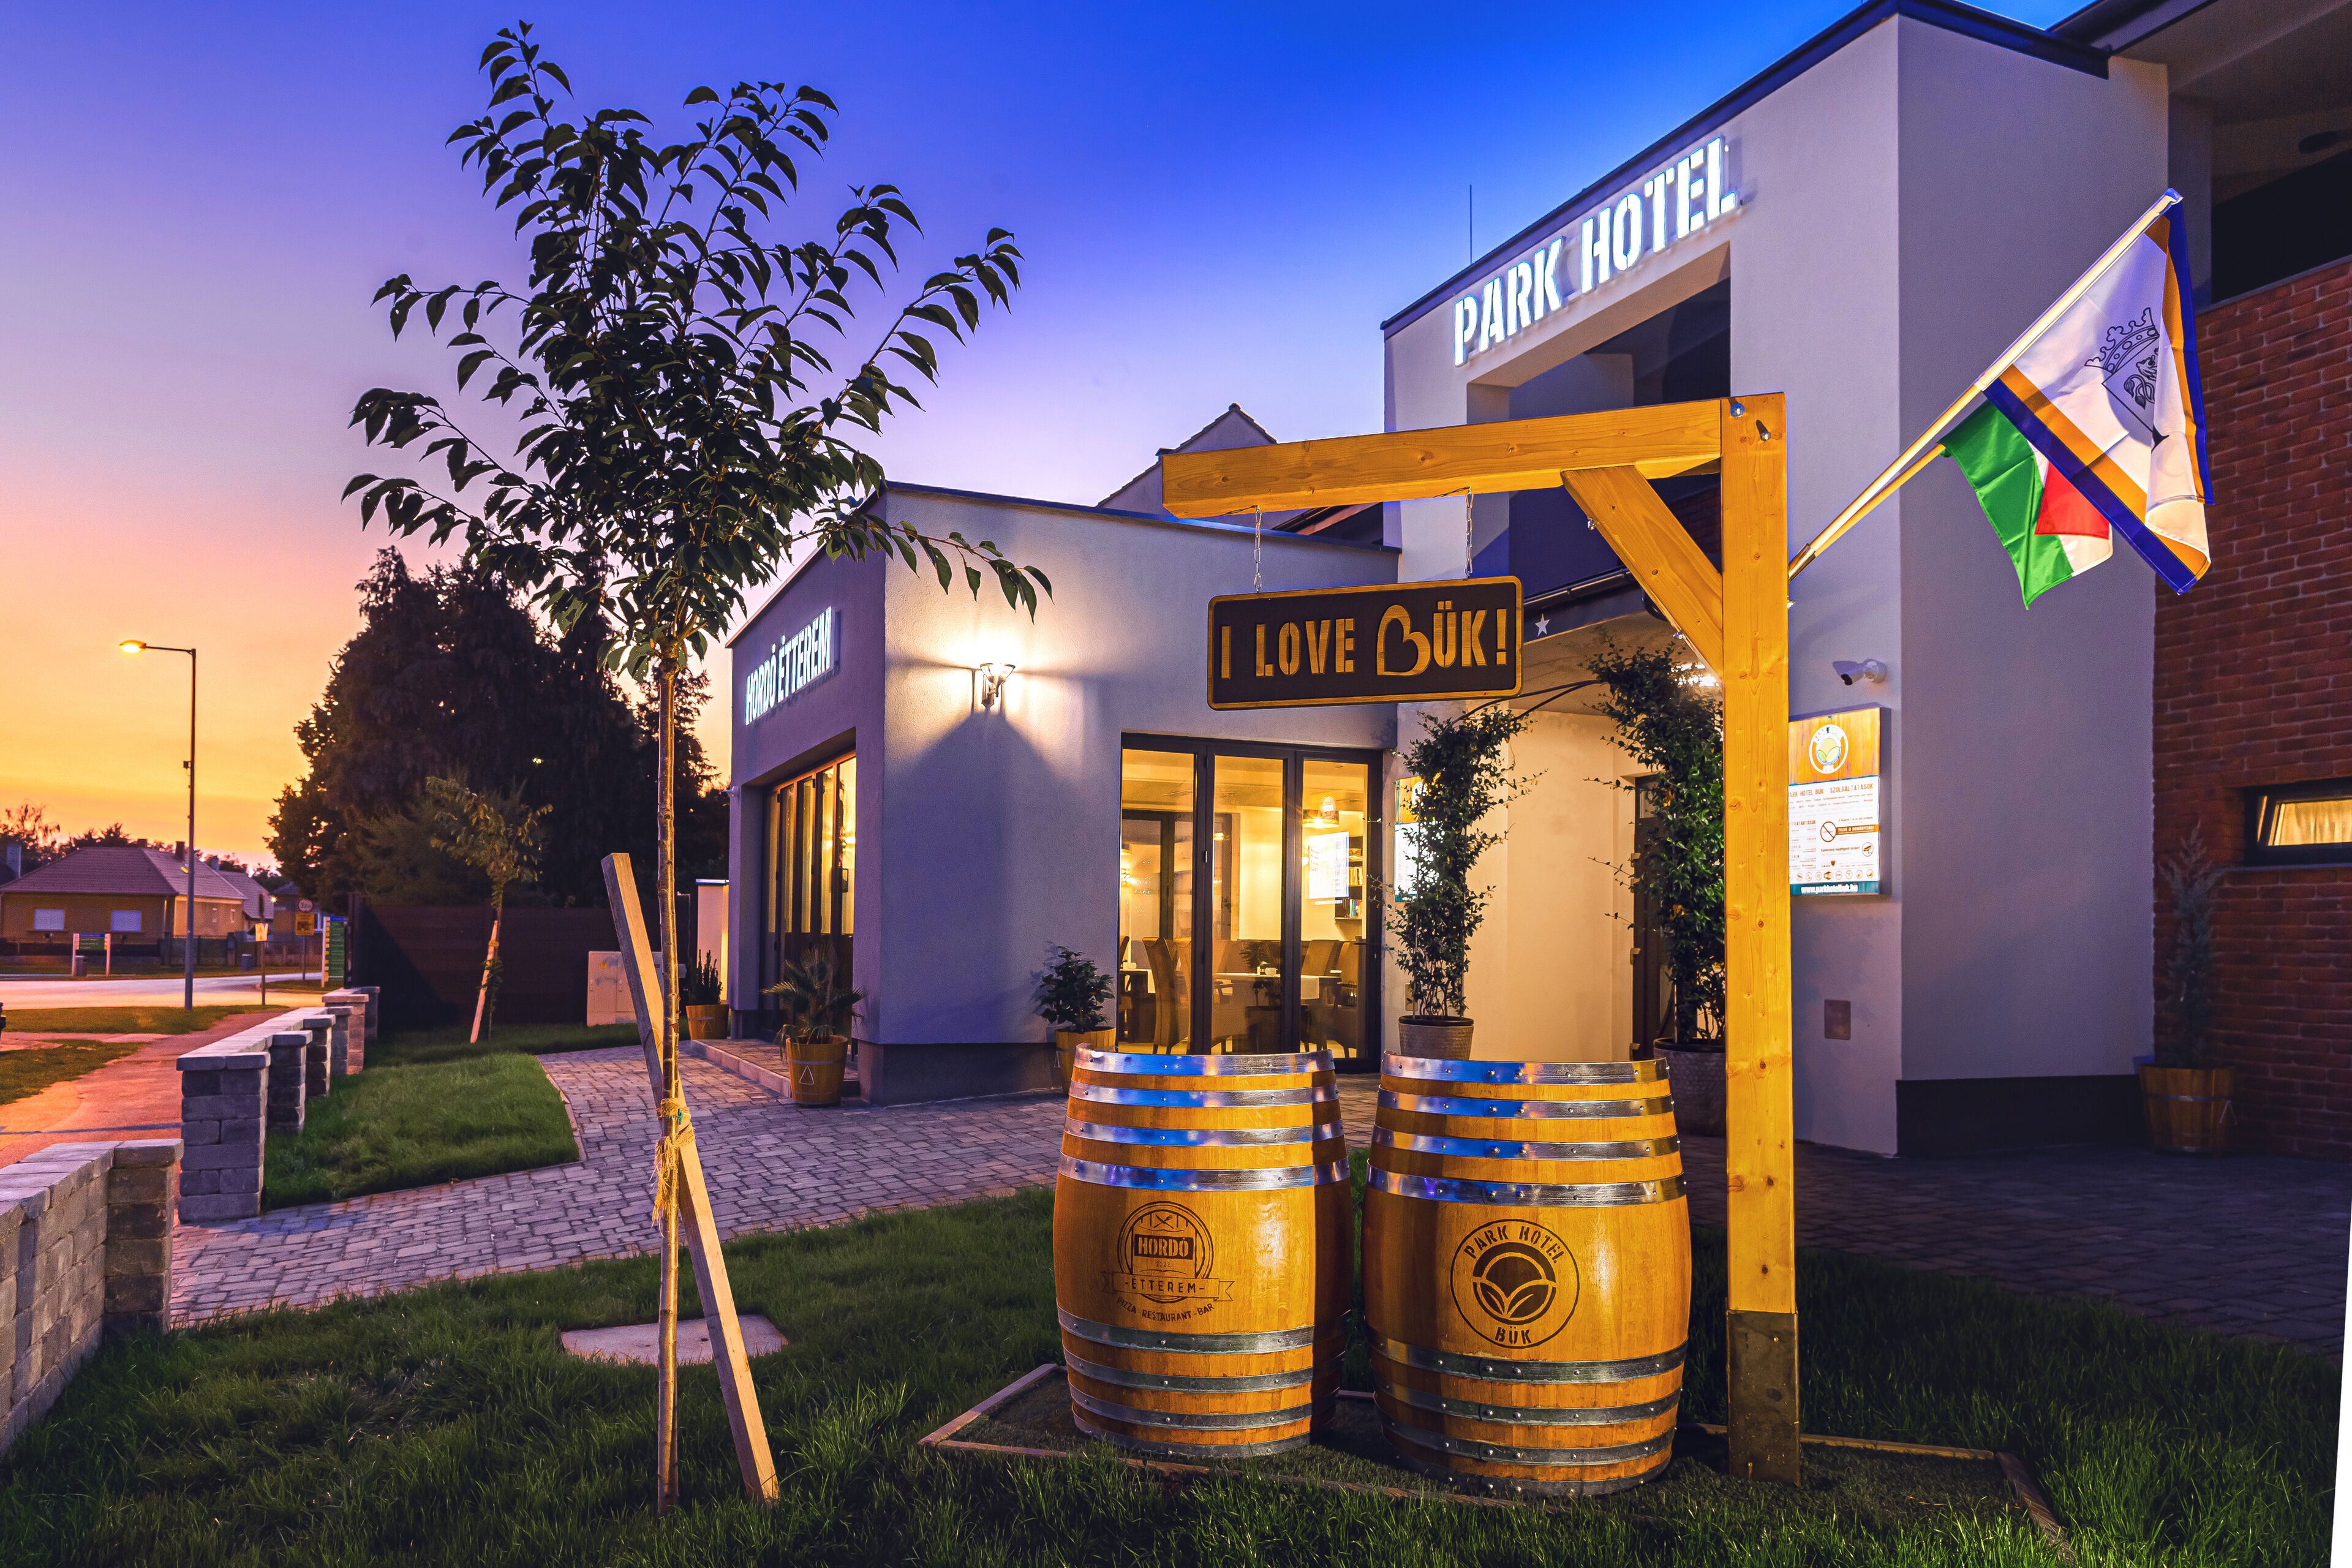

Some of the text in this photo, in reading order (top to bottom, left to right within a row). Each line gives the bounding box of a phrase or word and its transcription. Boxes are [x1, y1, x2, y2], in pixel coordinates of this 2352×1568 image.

[1454, 137, 1736, 366] PARK HOTEL
[745, 605, 832, 726] HORDÓ ÉTTEREM
[1221, 600, 1507, 679] I LOVE BÜK!
[1464, 1225, 1564, 1264] PARK HOTEL
[1117, 1297, 1137, 1314] PIZZA
[1494, 1326, 1532, 1344] BÜK
